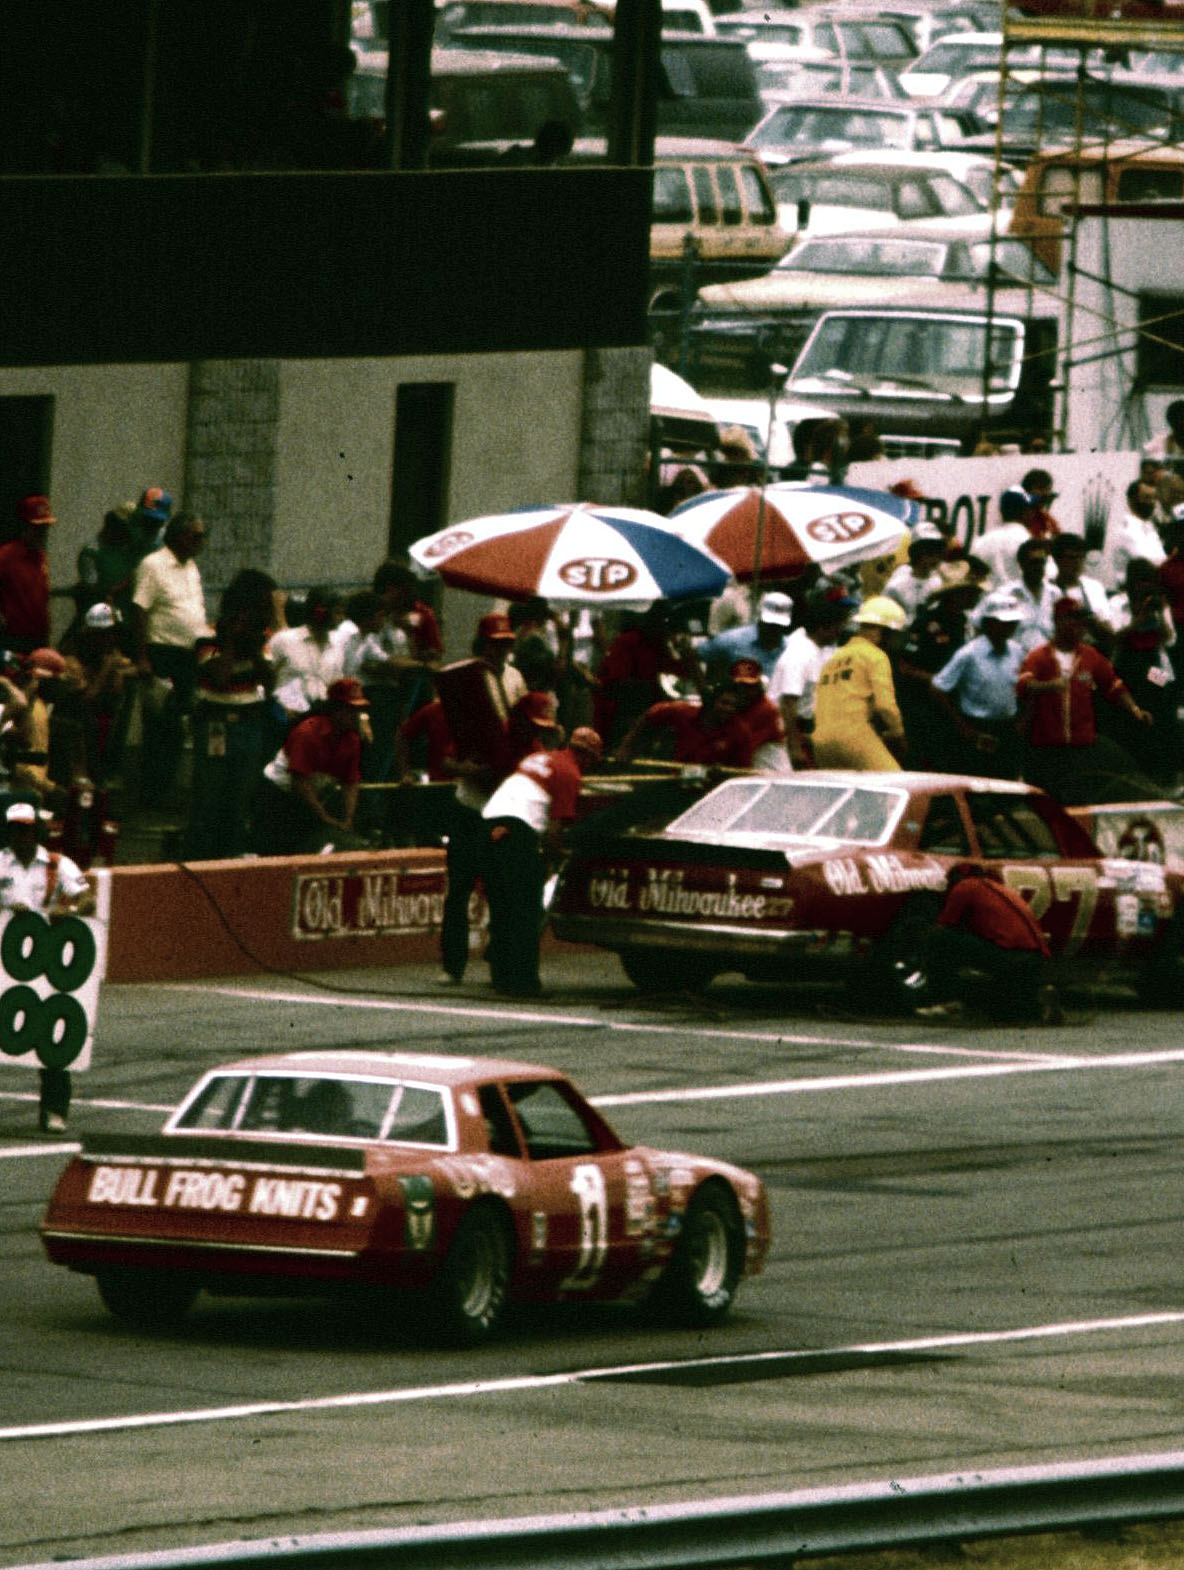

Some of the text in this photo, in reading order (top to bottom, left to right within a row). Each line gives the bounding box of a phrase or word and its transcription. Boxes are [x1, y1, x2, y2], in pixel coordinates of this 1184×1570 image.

[564, 558, 630, 588] STP
[305, 878, 344, 930] Old
[640, 867, 767, 919] Milwaukee
[89, 1166, 159, 1206] BULL
[164, 1171, 246, 1211] FROG
[249, 1177, 343, 1221] KNITS
